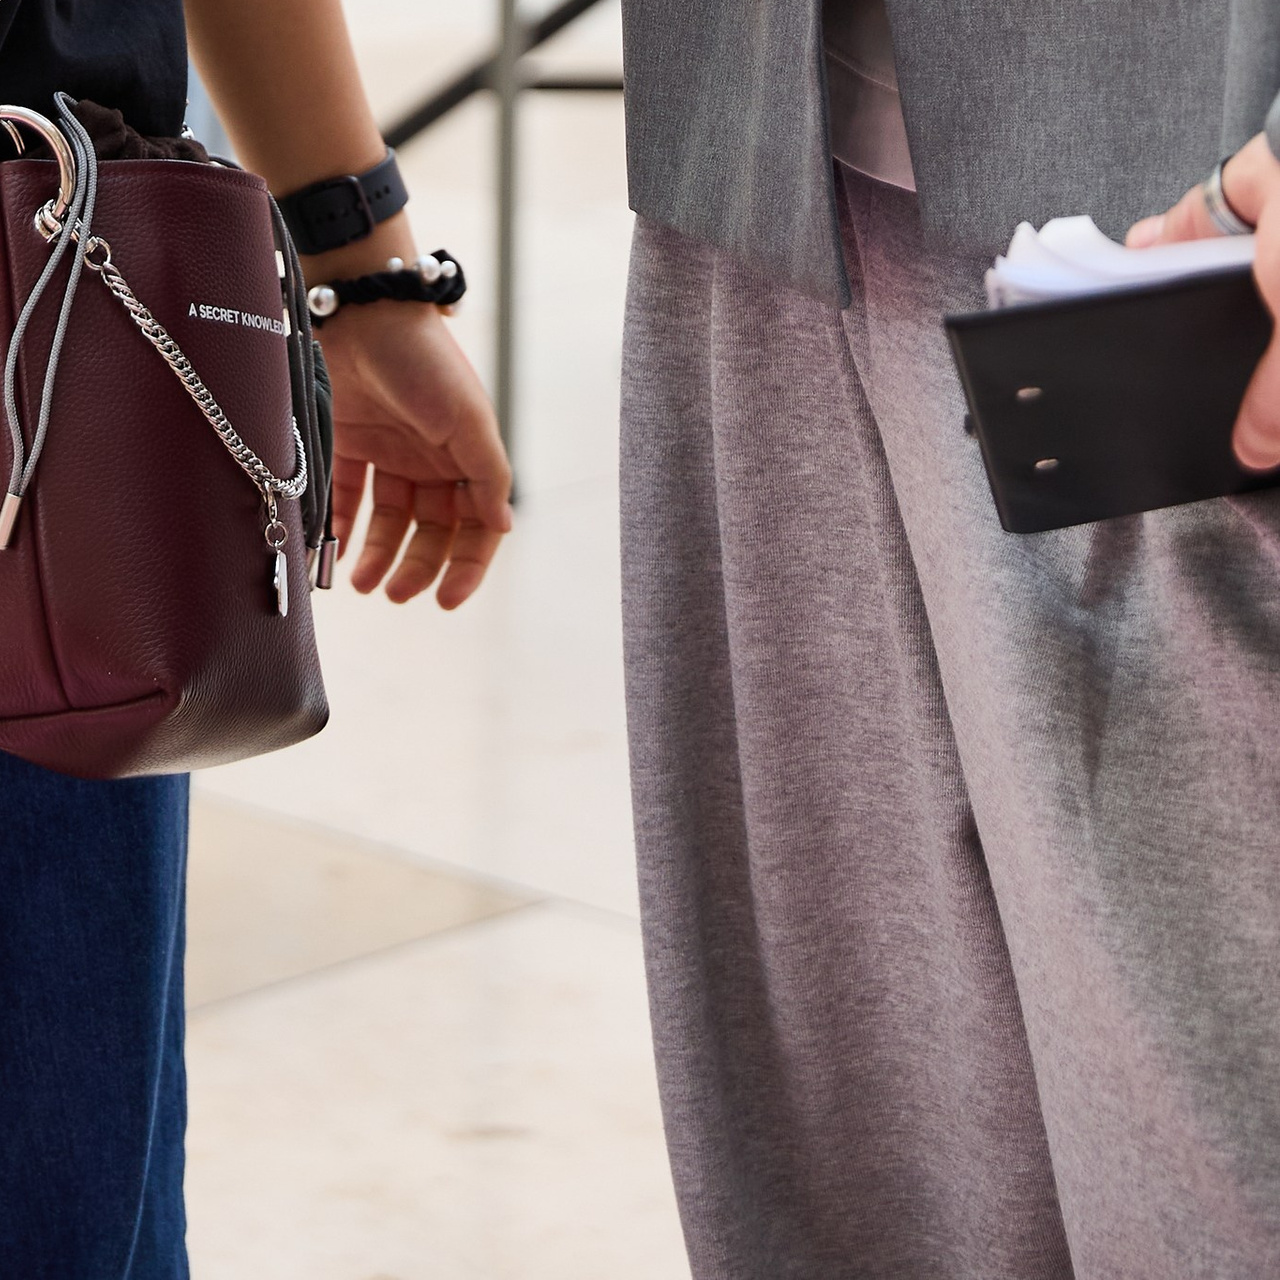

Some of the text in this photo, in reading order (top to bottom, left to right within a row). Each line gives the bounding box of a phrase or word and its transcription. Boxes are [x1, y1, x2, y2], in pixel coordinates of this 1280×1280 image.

[188, 302, 285, 335] A SECRET KNOWLED
